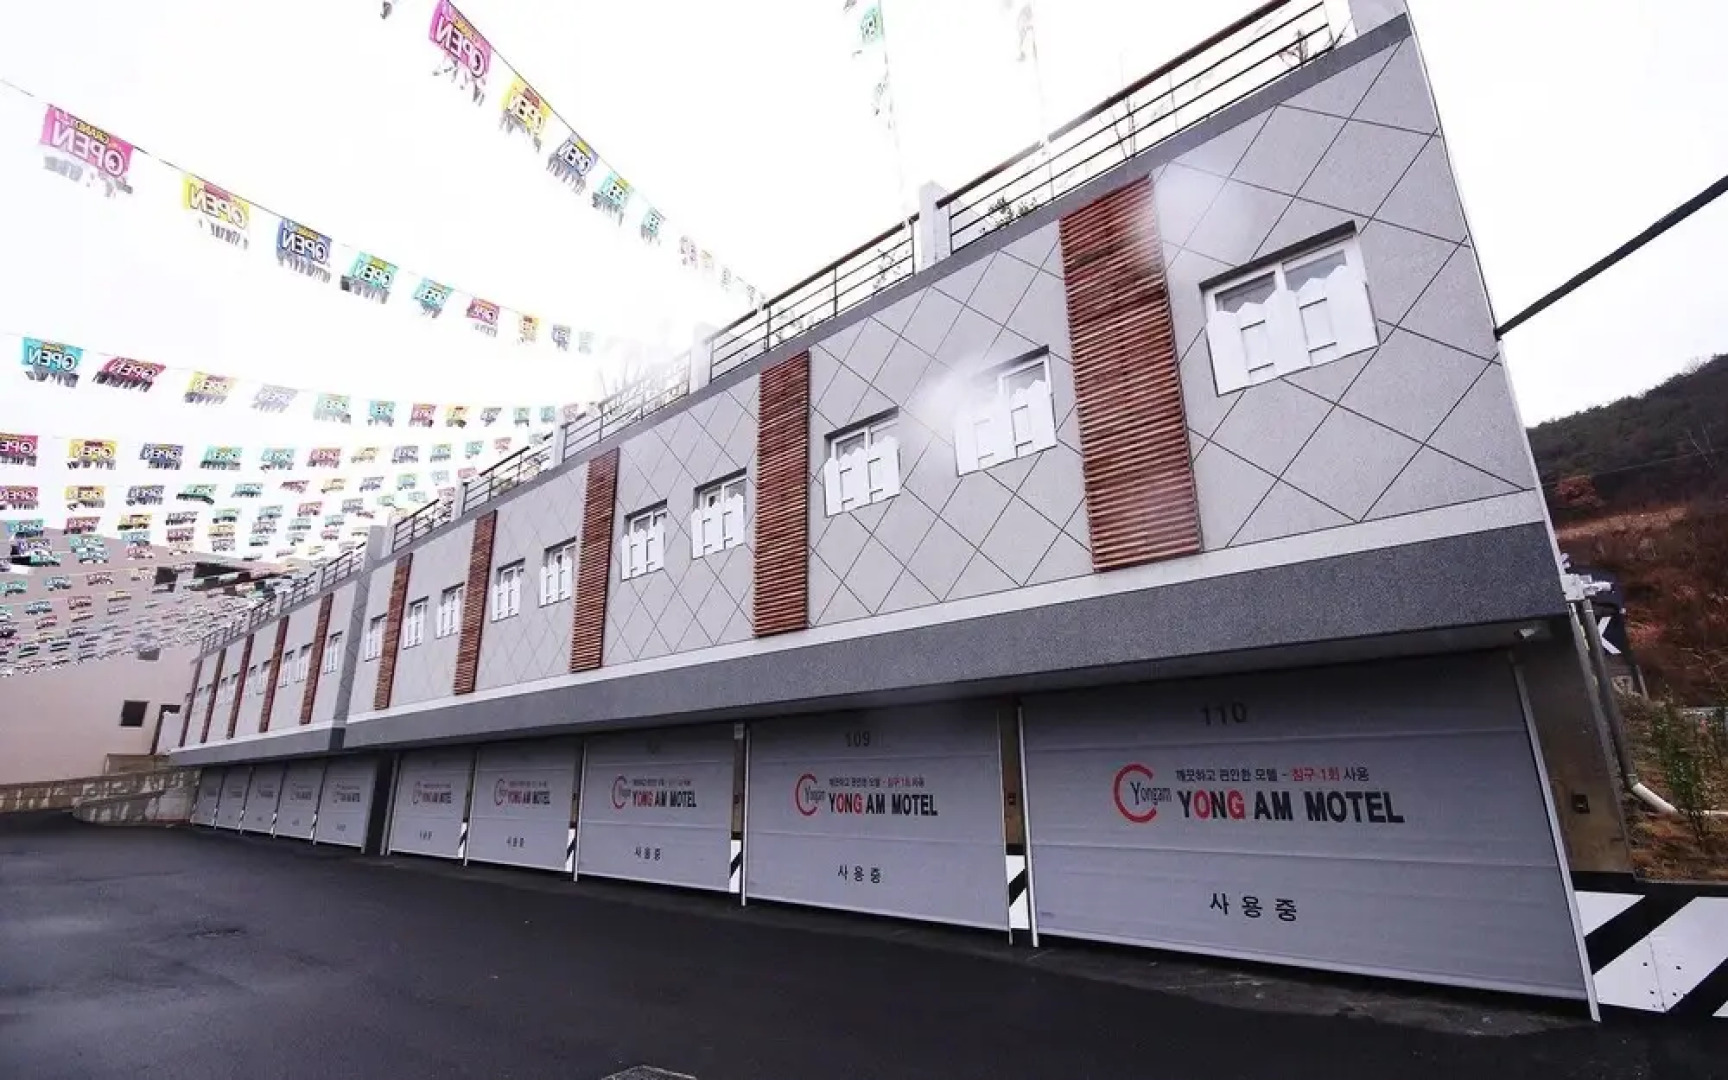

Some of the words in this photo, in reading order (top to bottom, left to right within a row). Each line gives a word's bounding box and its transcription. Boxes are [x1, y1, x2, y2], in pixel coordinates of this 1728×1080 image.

[1201, 701, 1247, 726] 110
[845, 731, 871, 747] 109
[1255, 768, 1278, 782] 모텔
[1343, 766, 1369, 782] 사용
[632, 790, 653, 808] YONG
[669, 790, 697, 808] MOTEL
[828, 792, 863, 814] YONG
[865, 793, 886, 815] AM
[891, 793, 938, 817] MOTEL
[1129, 781, 1172, 806] Yongam
[1176, 789, 1246, 820] YONG
[1254, 790, 1294, 821] AM
[1303, 790, 1405, 823] MOTEL
